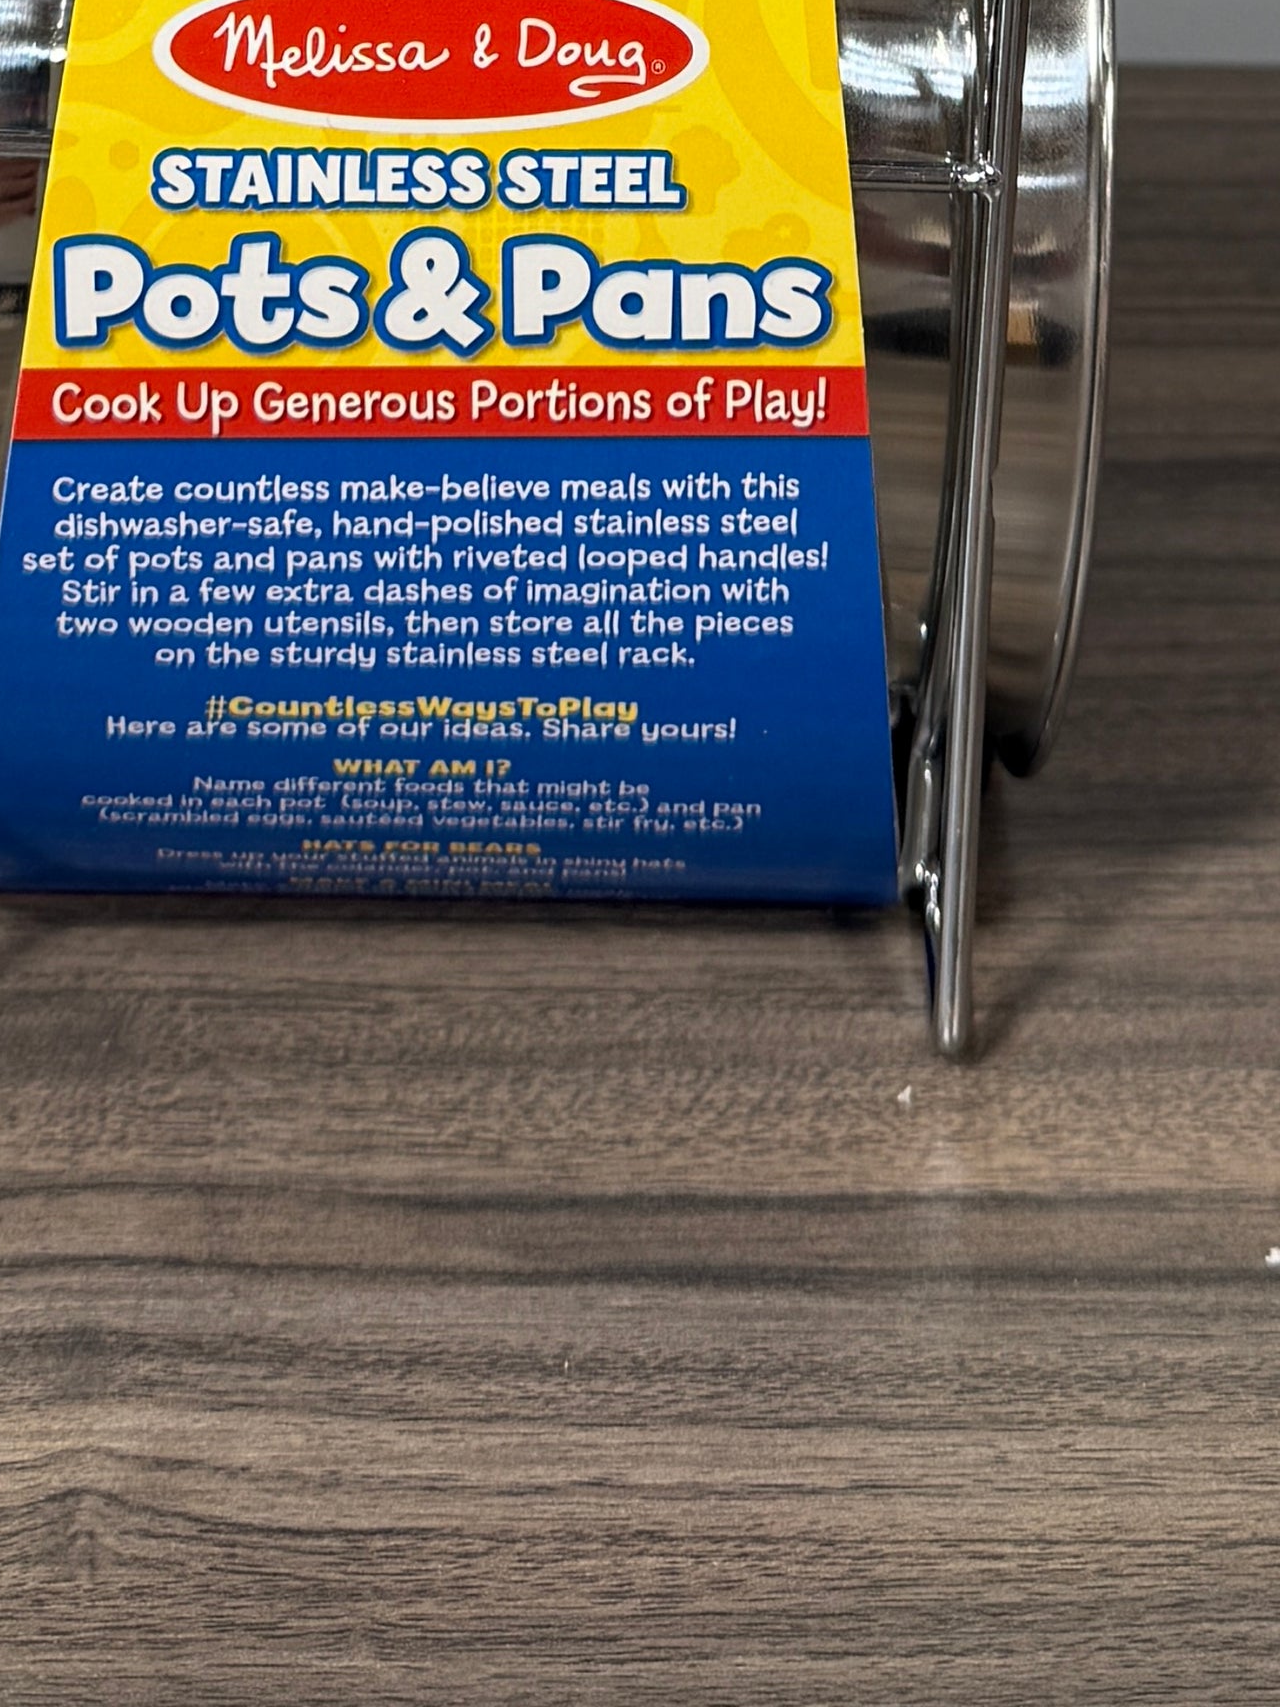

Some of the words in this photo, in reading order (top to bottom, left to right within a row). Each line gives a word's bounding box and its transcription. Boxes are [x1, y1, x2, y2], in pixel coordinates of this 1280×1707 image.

[212, 7, 451, 90] Melissa
[472, 19, 498, 69] &
[154, 150, 492, 207] STAINLESS
[502, 151, 684, 207] STEEL
[58, 236, 365, 347] Pots
[380, 232, 490, 352] &
[508, 237, 830, 347] Pans
[51, 380, 162, 425] Cook
[176, 380, 240, 437] Up
[252, 380, 456, 425] Generous
[470, 379, 652, 423] Portions
[665, 375, 714, 423] of
[724, 375, 828, 431] Play!
[52, 476, 163, 502] Create
[174, 474, 329, 503] countless
[340, 473, 550, 502] make-believe
[561, 472, 651, 501] meals
[662, 472, 730, 501] with
[742, 472, 800, 501] this
[54, 508, 322, 539] dishwasher-safe,
[333, 509, 562, 544] hand-polished
[574, 508, 709, 537] stainless
[721, 507, 798, 537] steel
[22, 546, 74, 572] set
[84, 545, 119, 572] of
[129, 546, 202, 578] pots
[213, 546, 274, 572] and
[287, 550, 362, 578] pans
[374, 544, 442, 571] with
[453, 544, 567, 571] riveted
[579, 544, 687, 576] looped
[699, 542, 828, 571] handles!
[62, 579, 120, 604] Stir
[131, 581, 158, 605] in
[170, 584, 189, 603] a
[200, 577, 255, 604] few
[266, 579, 353, 603] extra
[364, 578, 472, 604] dashes
[483, 576, 518, 603] of
[527, 577, 710, 605] imagination
[722, 577, 789, 604] with
[56, 611, 118, 636] two
[129, 612, 253, 636] wooden
[264, 611, 394, 637] utensils,
[404, 610, 479, 637] then
[490, 610, 572, 635] store
[584, 610, 619, 635] all
[631, 610, 683, 635] the
[696, 612, 793, 643] pieces
[155, 647, 194, 666] on
[207, 642, 259, 666] the
[270, 642, 376, 670] sturdy
[386, 642, 520, 666] stainless
[532, 641, 607, 668] steel
[619, 642, 695, 667] rack.
[205, 695, 638, 723] #CountlessWaysToPlay
[107, 716, 176, 738] Here
[187, 720, 236, 737] are
[247, 720, 328, 738] some
[339, 717, 372, 737] of
[383, 720, 432, 738] our
[444, 718, 531, 738] ideas.
[543, 718, 630, 739] Share
[643, 718, 736, 742] yours!
[333, 758, 420, 775] WHAT
[428, 759, 476, 776] AM
[486, 759, 511, 776] I?
[193, 776, 265, 791] Name
[274, 777, 386, 793] different
[394, 778, 464, 794] foods
[473, 778, 529, 794] that
[537, 779, 611, 797] might
[619, 780, 650, 796] be
[81, 793, 173, 807] cooked
[180, 794, 203, 808] in
[211, 794, 272, 809] each
[279, 796, 326, 812] pot
[657, 800, 705, 815] and
[713, 801, 761, 817] pan
[583, 815, 624, 830] stir
